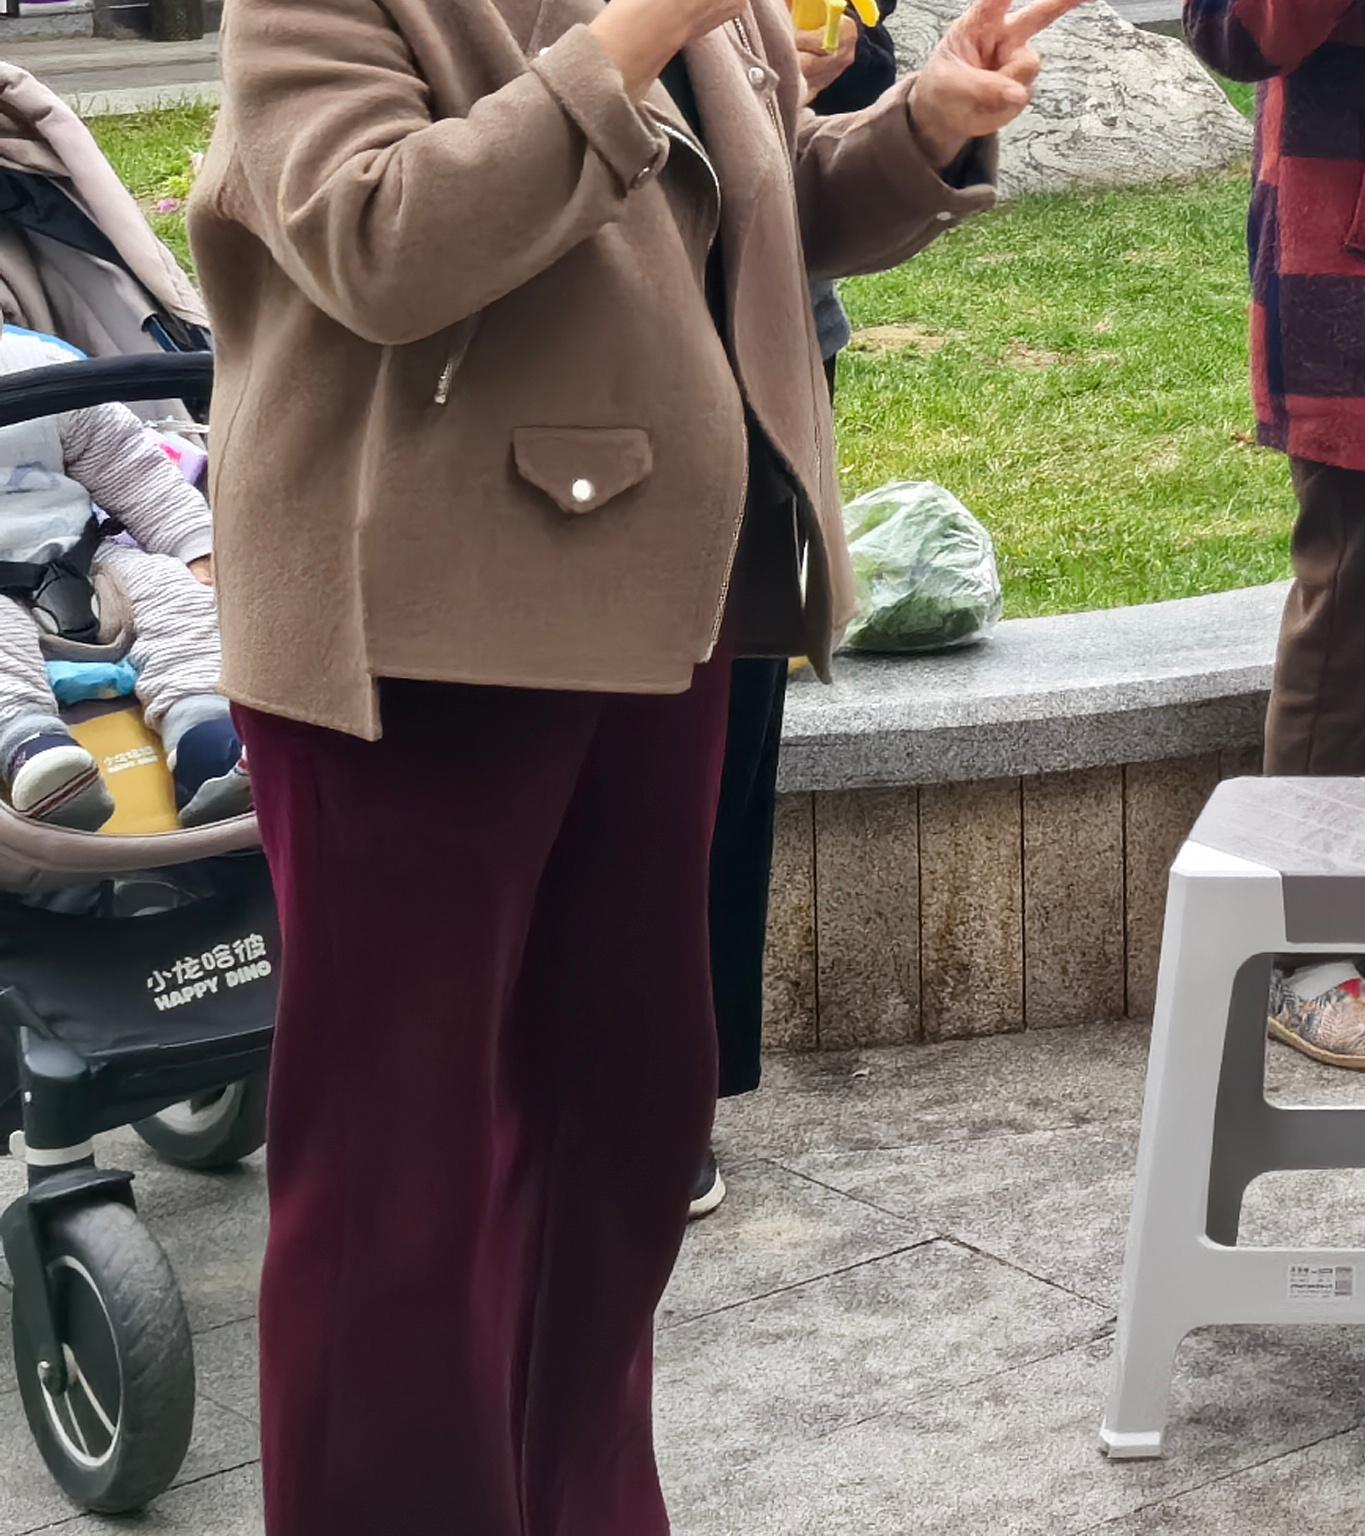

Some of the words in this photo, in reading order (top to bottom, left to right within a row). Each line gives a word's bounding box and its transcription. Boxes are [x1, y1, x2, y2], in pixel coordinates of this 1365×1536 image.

[146, 932, 267, 993] 小龙哈彼
[153, 975, 219, 1011] HAPPY
[224, 960, 272, 988] DINO
